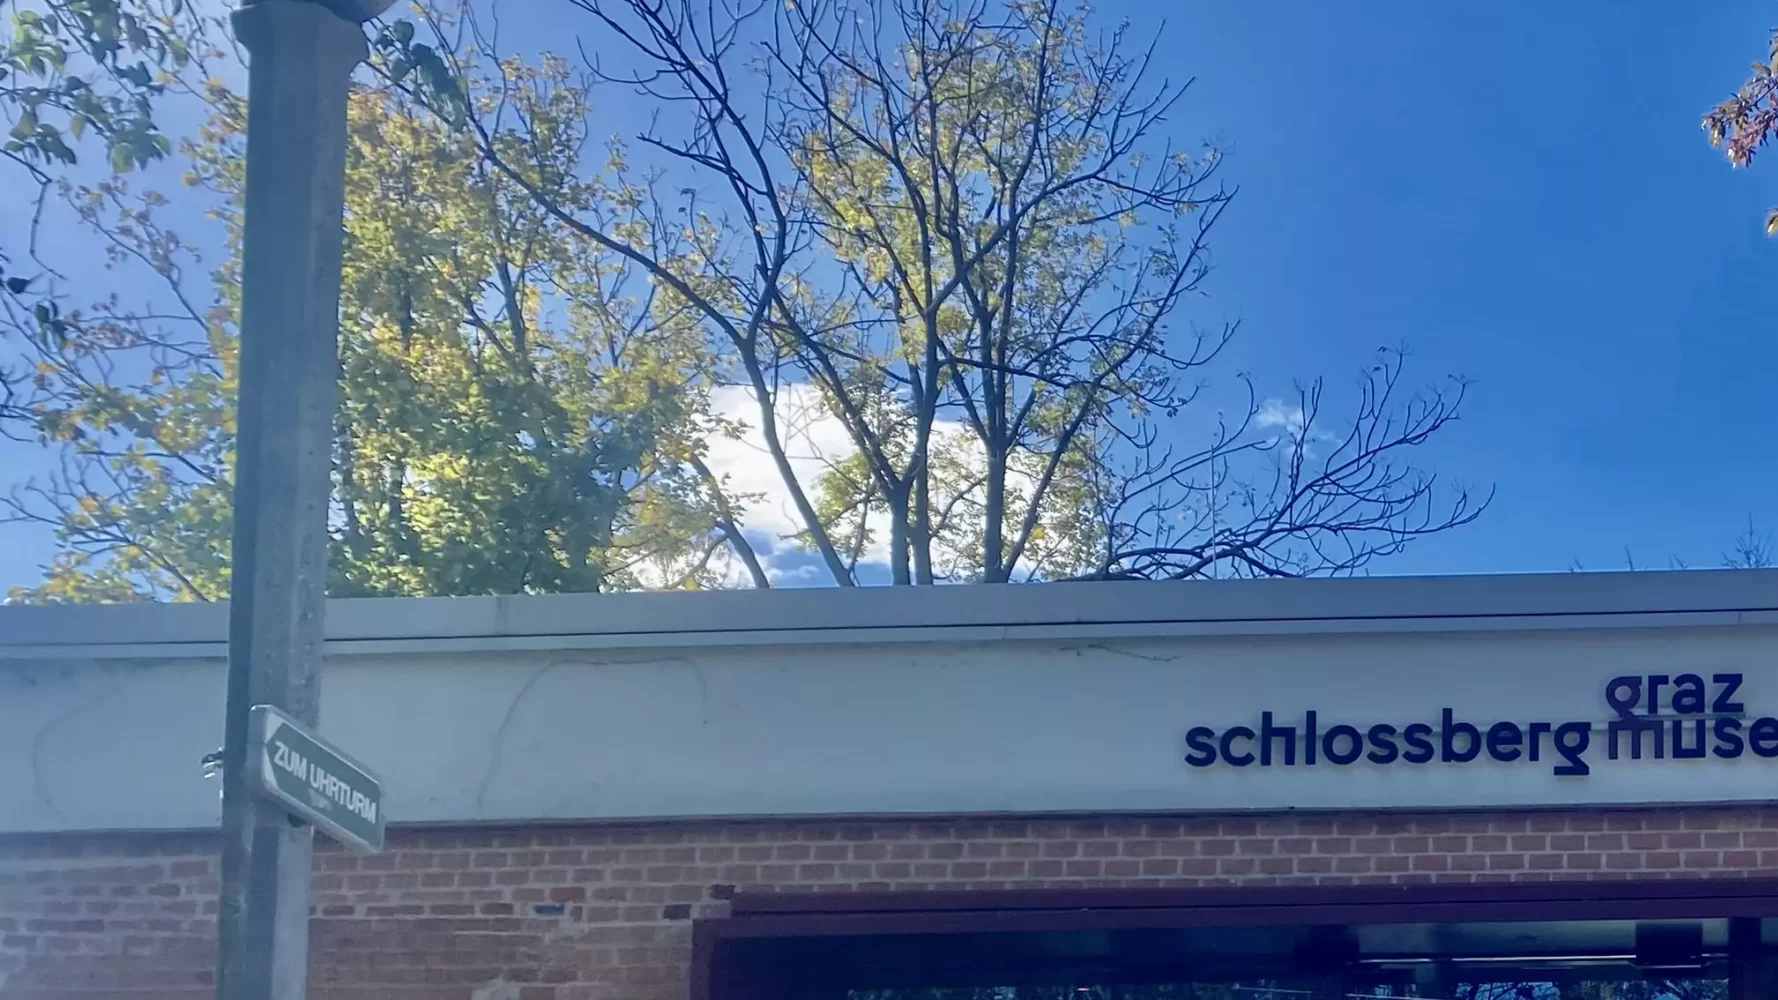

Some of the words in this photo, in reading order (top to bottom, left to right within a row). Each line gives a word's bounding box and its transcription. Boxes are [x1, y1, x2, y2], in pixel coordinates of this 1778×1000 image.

[1605, 673, 1744, 720] graz
[1184, 707, 1592, 776] schlossberg
[273, 740, 308, 781] ZUM
[310, 763, 376, 823] UHRTURM
